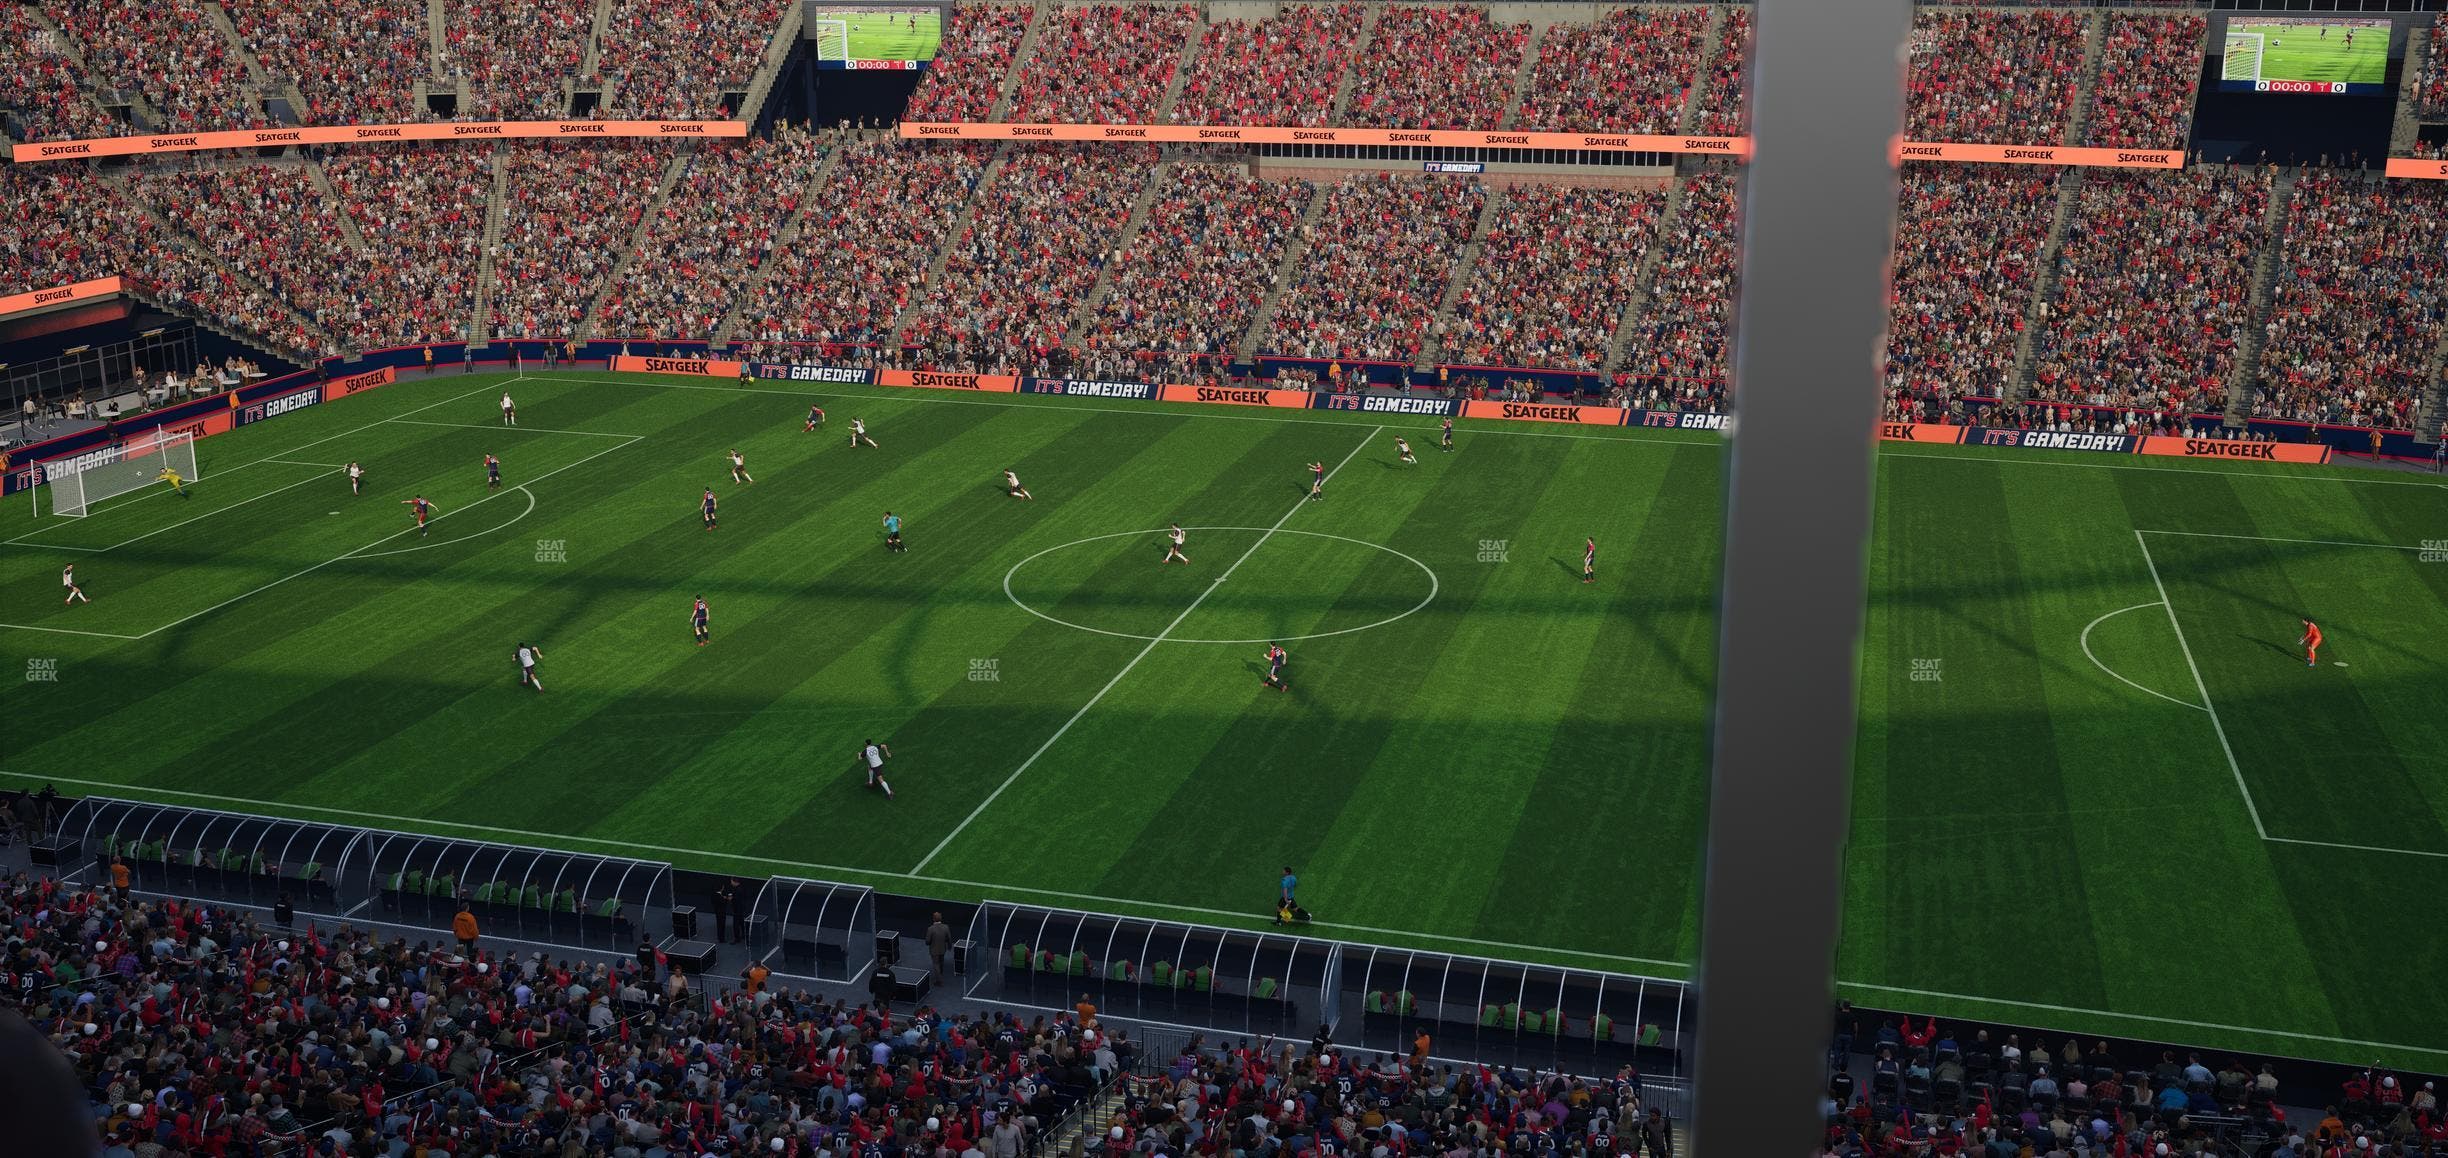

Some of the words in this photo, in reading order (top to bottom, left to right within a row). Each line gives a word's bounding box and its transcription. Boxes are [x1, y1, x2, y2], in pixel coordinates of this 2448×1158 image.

[859, 61, 889, 69] 00:00
[2272, 82, 2311, 92] 00:00
[357, 128, 401, 138] SEATGEEK
[455, 125, 502, 135] SEATGEEK
[560, 124, 605, 133] SEATGEEK
[661, 124, 704, 133] SEATGEEK
[920, 126, 960, 135] SEATGEEK
[1013, 127, 1054, 136] SEATGEEK
[1106, 128, 1147, 138] SEATGEEK
[1199, 129, 1241, 139] SEATGEEK
[256, 132, 301, 143] SEATGEEK
[1294, 131, 1336, 141] SEATGEEK
[1390, 133, 1432, 143] SEATGEEK
[1486, 135, 1529, 145] SEATGEEK
[151, 137, 198, 149] SEATGEEK
[1585, 138, 1629, 148] SEATGEEK
[1685, 140, 1730, 150] SEATGEEK
[42, 144, 91, 157] SEATGEEK
[1902, 146, 1942, 157] EATGEEK
[2004, 149, 2054, 160] SEATGEEK
[2118, 152, 2169, 165] SEATGEEK
[34, 287, 73, 304] SEATGEEK
[646, 358, 709, 375] SEATGEEK
[760, 364, 787, 379] IT'S
[790, 365, 866, 383] GAMEDAY!
[346, 370, 386, 393] SEATGEEK
[912, 372, 980, 389] SEATGEEK
[1035, 379, 1063, 394] IT'S
[1067, 381, 1148, 400] GAMEDAY!
[1197, 387, 1269, 405] SEATGEEK
[244, 404, 263, 424] IT'S
[266, 388, 317, 417] GAMEDAY!
[1328, 394, 1359, 410] IT'S
[1363, 396, 1450, 415] GAMEDAY!
[1502, 403, 1580, 422] SEATGEEK
[1643, 411, 1677, 427] IT'S
[1681, 413, 1731, 430] GAME
[1983, 429, 2020, 446] IT'S
[2023, 431, 2125, 452] GAMEDAY!
[2185, 439, 2275, 460] SEATGEEK
